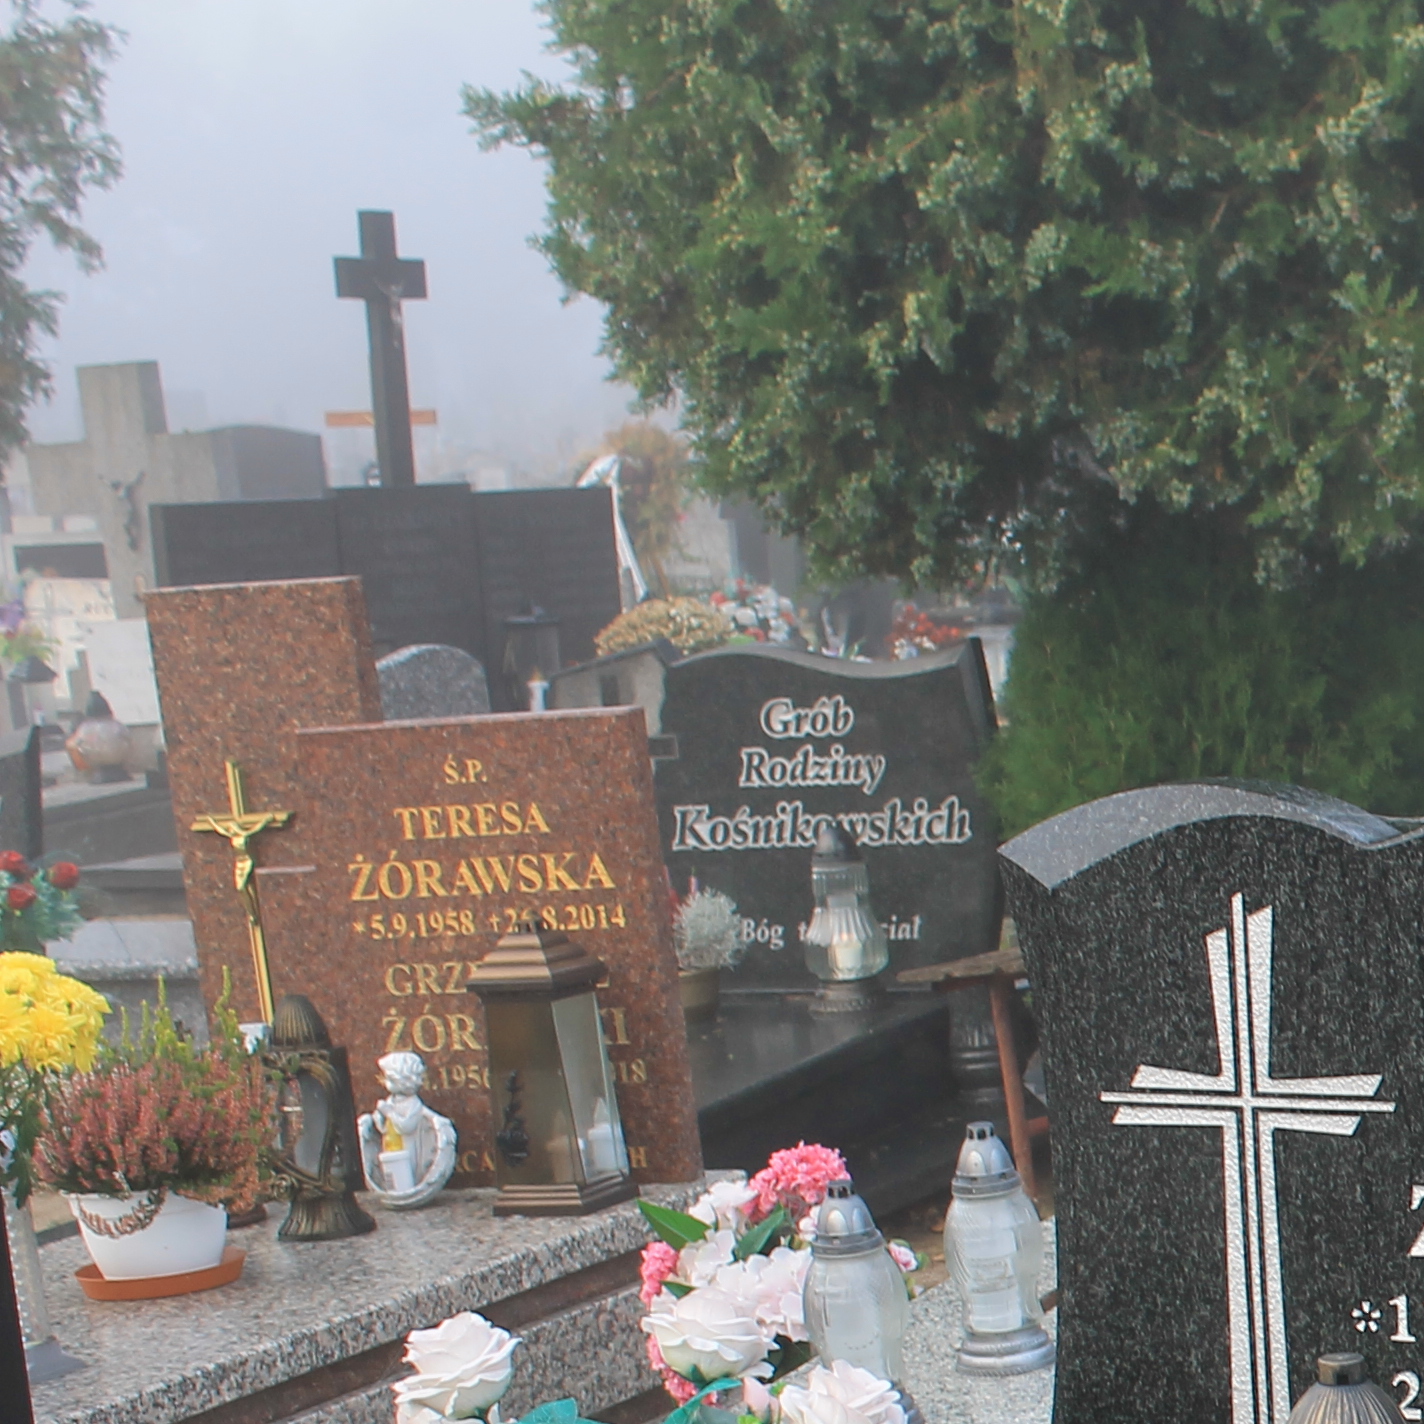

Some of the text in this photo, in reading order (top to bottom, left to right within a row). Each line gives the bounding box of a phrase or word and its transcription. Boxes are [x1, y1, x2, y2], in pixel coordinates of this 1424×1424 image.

[760, 694, 855, 739] Grób
[443, 754, 488, 785] Ś.P.
[738, 744, 887, 795] Rodziny
[393, 801, 551, 841] TERESA
[672, 795, 973, 852] Kośnikowskich
[347, 850, 616, 901] ŻÓRAWSKA
[740, 917, 784, 949] Bóg
